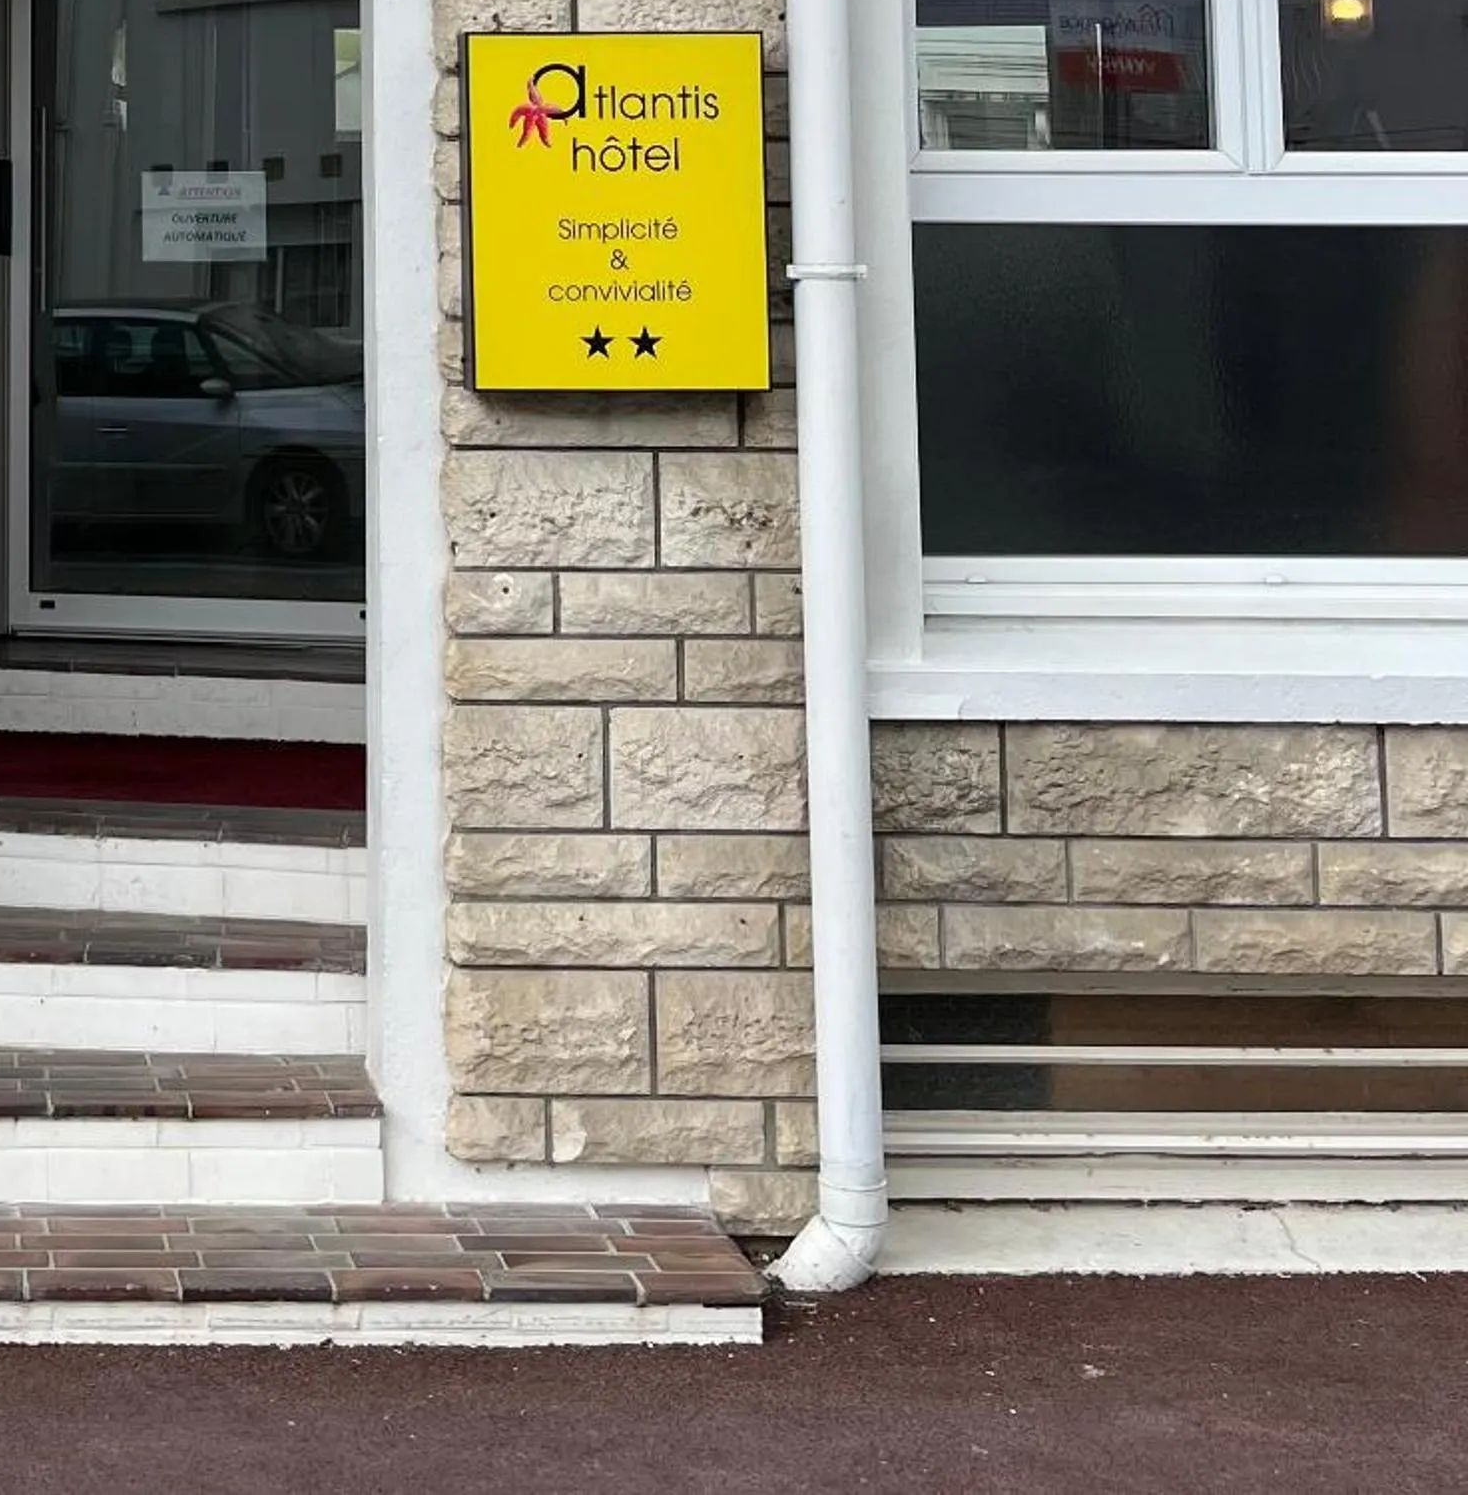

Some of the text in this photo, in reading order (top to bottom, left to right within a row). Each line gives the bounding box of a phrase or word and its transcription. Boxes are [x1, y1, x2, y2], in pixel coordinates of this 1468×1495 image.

[532, 63, 720, 121] atlantis
[572, 136, 680, 173] hôtel
[171, 212, 238, 225] OUVERTURE
[163, 230, 247, 242] AUTOMATIQUE
[558, 218, 679, 243] Simplicité
[610, 249, 629, 271] &
[548, 280, 692, 303] convivialité
